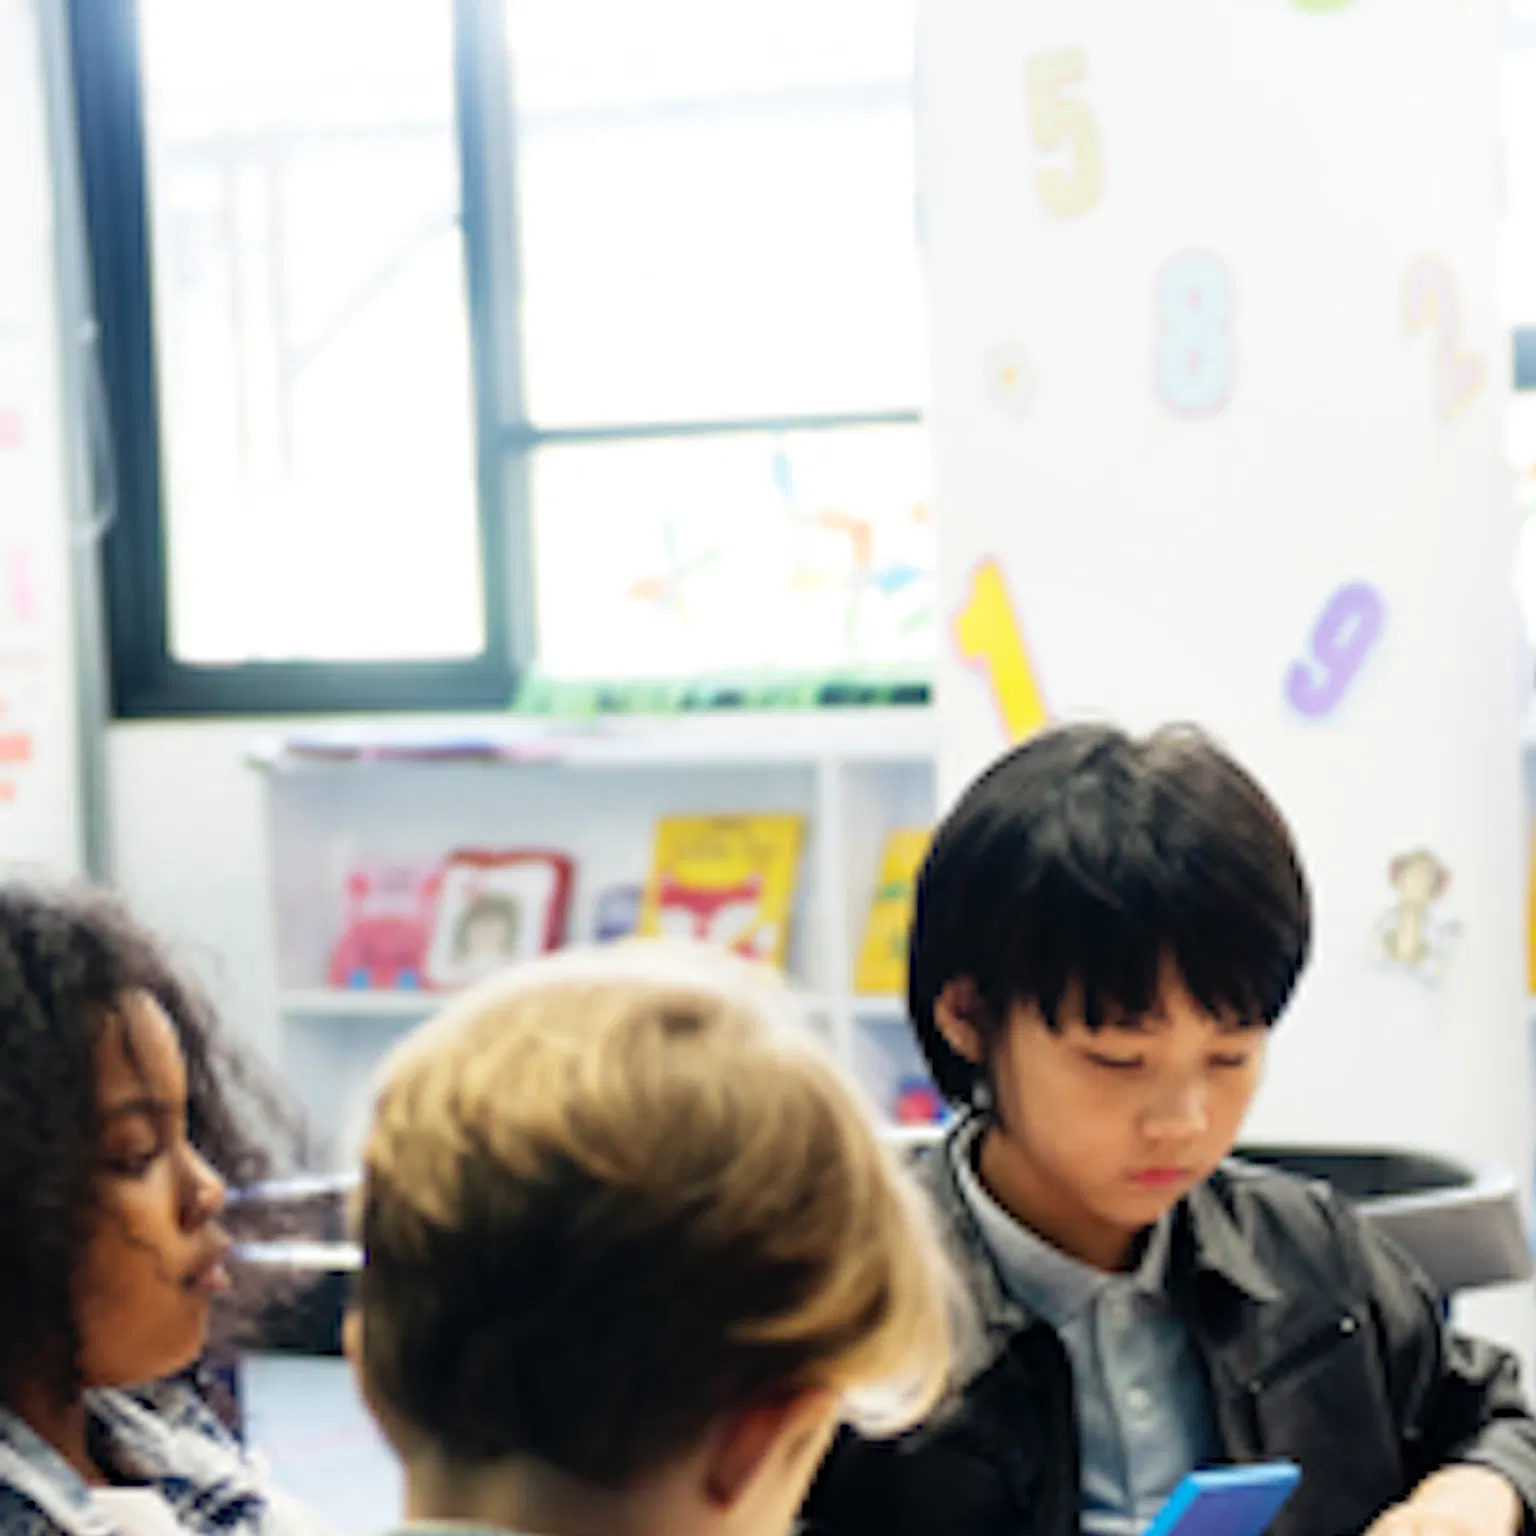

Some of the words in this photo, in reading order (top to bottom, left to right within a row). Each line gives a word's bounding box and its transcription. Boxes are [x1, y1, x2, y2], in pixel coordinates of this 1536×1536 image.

[1024, 43, 1103, 220] 5
[1155, 247, 1238, 420] 8
[953, 553, 1051, 741] 1
[1285, 578, 1386, 717] 9
